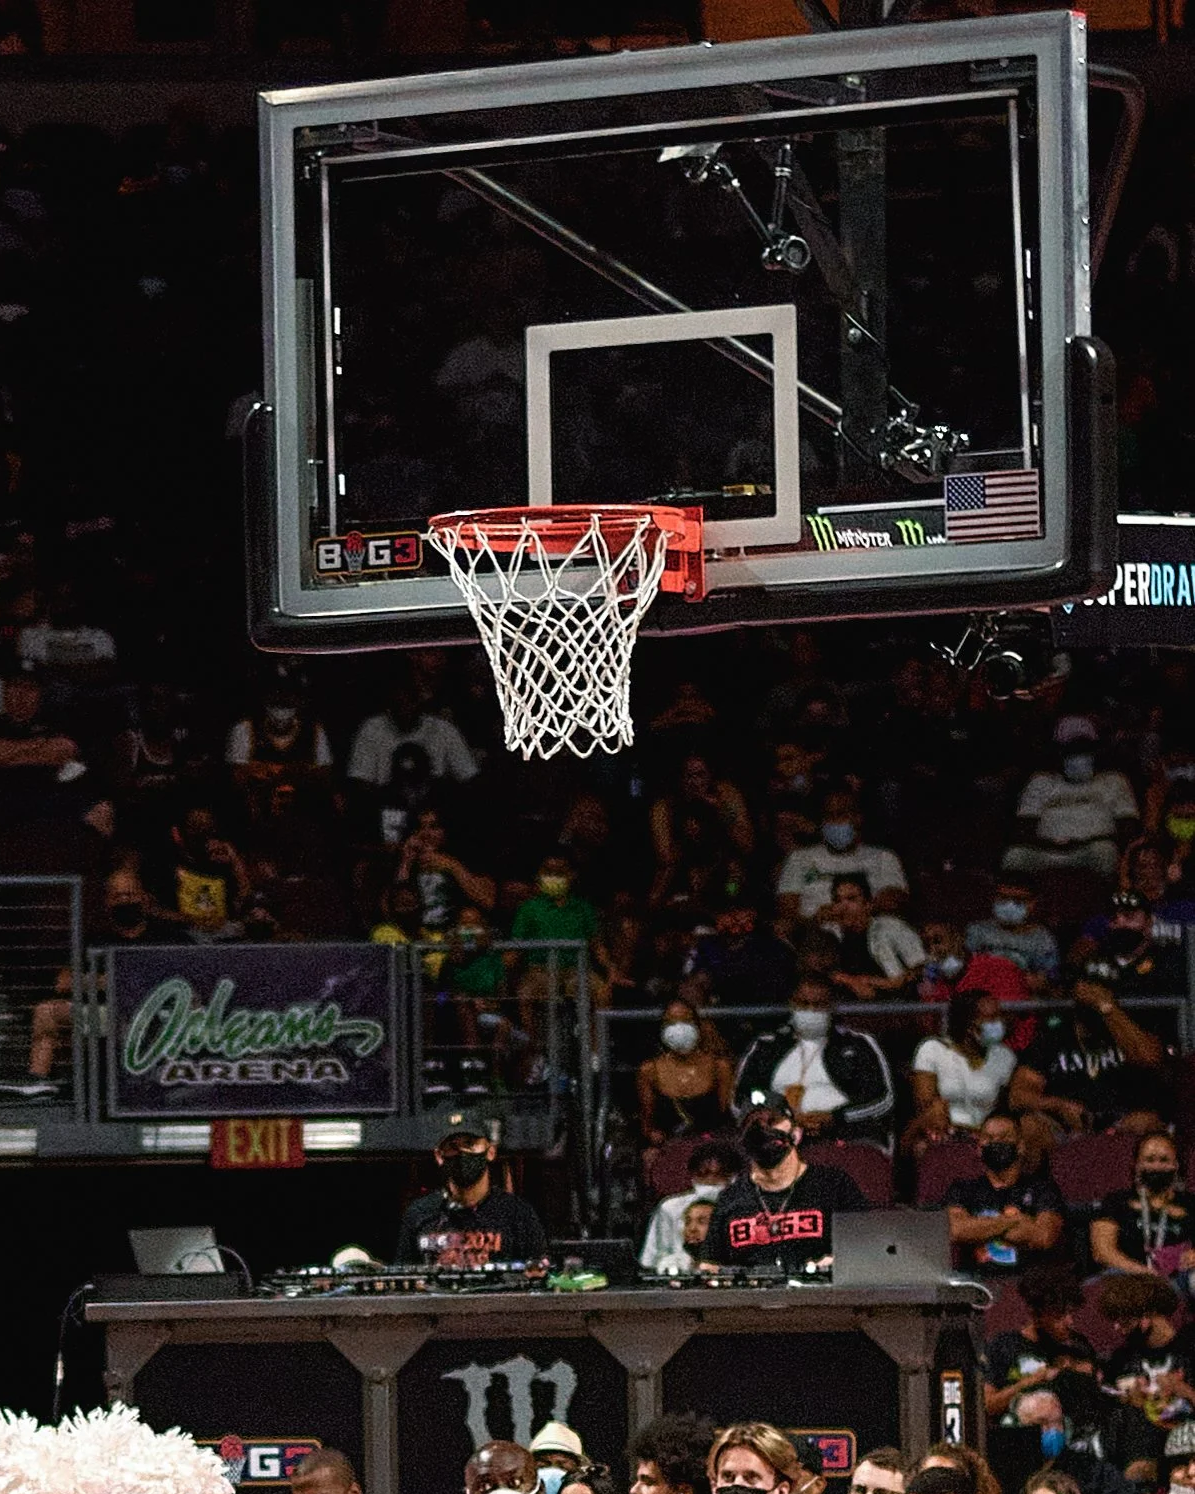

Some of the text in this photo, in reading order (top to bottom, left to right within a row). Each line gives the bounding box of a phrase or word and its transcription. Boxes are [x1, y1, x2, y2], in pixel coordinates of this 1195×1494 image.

[1083, 562, 1195, 606] PERDRA
[159, 1058, 349, 1084] ARENA
[226, 1119, 291, 1163] EXIT
